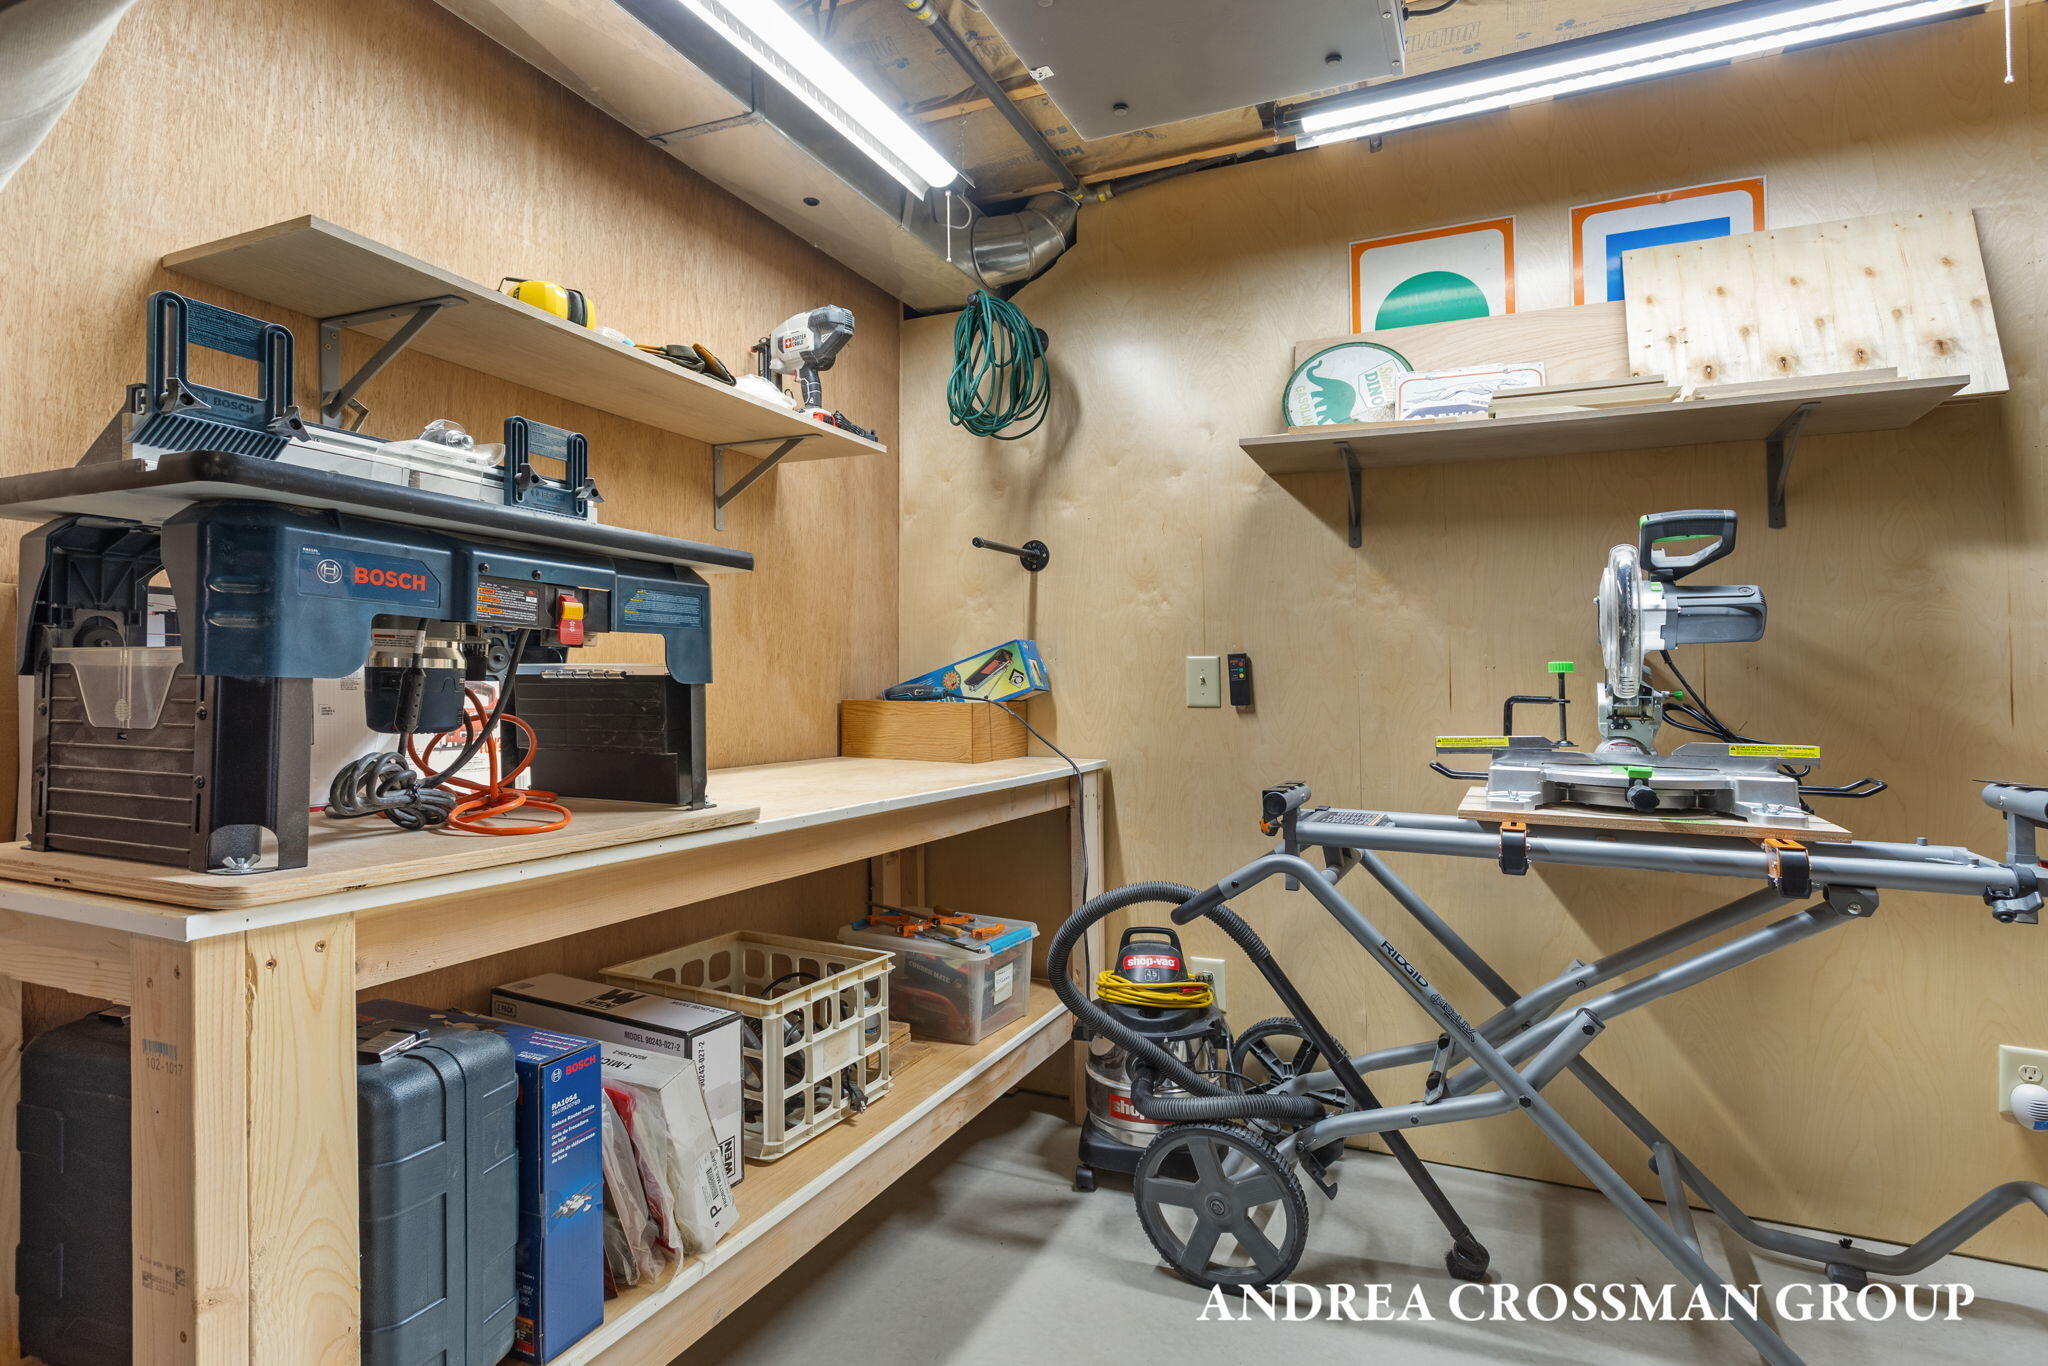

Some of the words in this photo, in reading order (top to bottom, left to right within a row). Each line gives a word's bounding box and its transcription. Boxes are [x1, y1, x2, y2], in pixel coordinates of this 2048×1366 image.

[1364, 371, 1385, 406] DINO
[213, 397, 255, 414] BOSCH
[354, 566, 427, 591] BOSCH
[1380, 940, 1429, 987] RIDGID
[624, 1031, 645, 1043] MODEL
[146, 1056, 184, 1077] 102-1017
[566, 1054, 597, 1076] BOSCH
[724, 1140, 733, 1176] WEN
